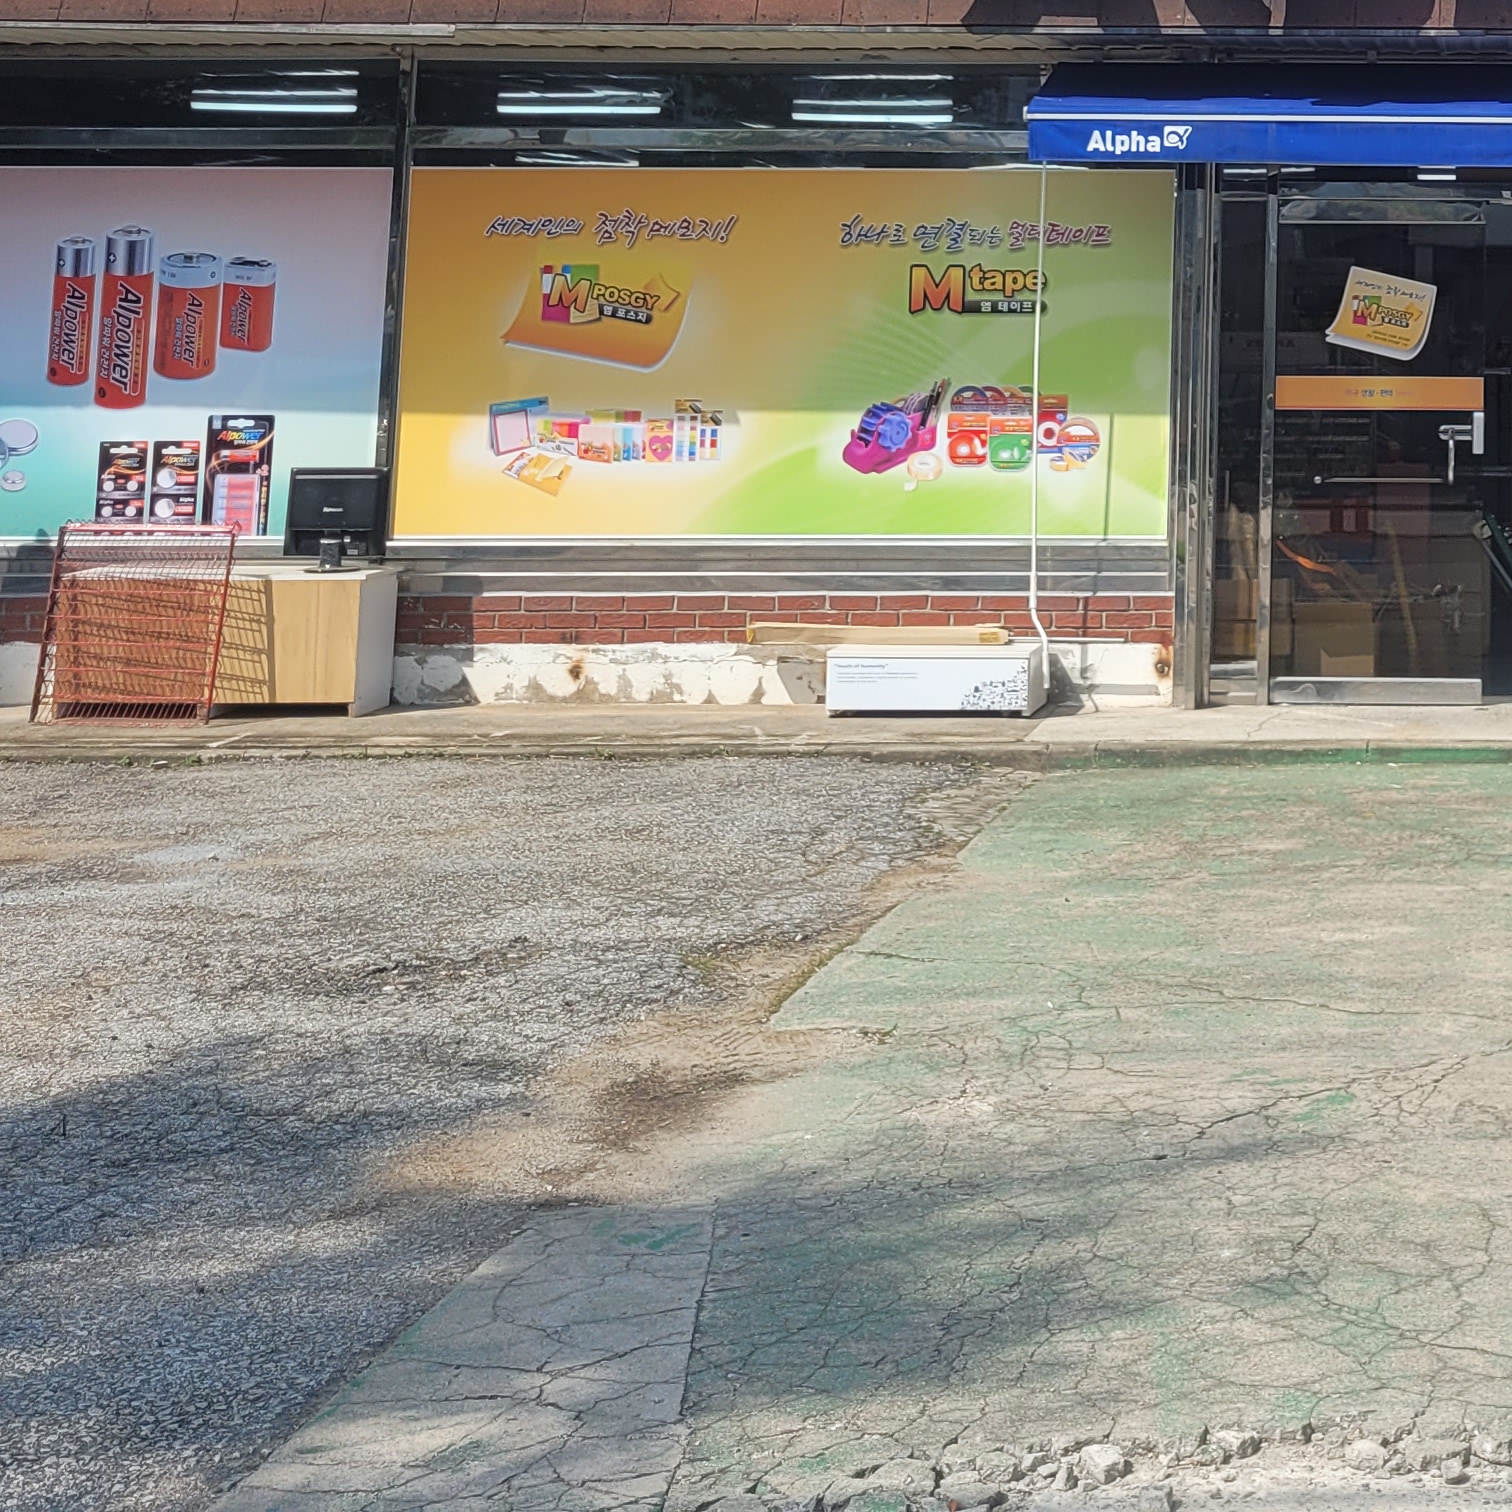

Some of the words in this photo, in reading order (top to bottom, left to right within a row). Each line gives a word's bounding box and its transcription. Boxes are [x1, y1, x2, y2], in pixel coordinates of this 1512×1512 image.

[1086, 129, 1161, 155] Alpha
[484, 215, 585, 238] 세계인의
[593, 207, 648, 248] 점착
[839, 212, 908, 247] 하나로
[912, 216, 1003, 252] 연결되는
[591, 283, 662, 311] POSGY
[968, 262, 1048, 299] tape
[236, 286, 253, 345] Alpower
[615, 308, 648, 323] 포스지
[998, 301, 1034, 313] 테이프
[1377, 305, 1414, 322] POSGY
[60, 281, 88, 373] Alpower
[110, 280, 144, 395] Alpower
[182, 291, 205, 368] Alpower
[100, 348, 111, 379] 건전지
[216, 430, 265, 442] Alpower
